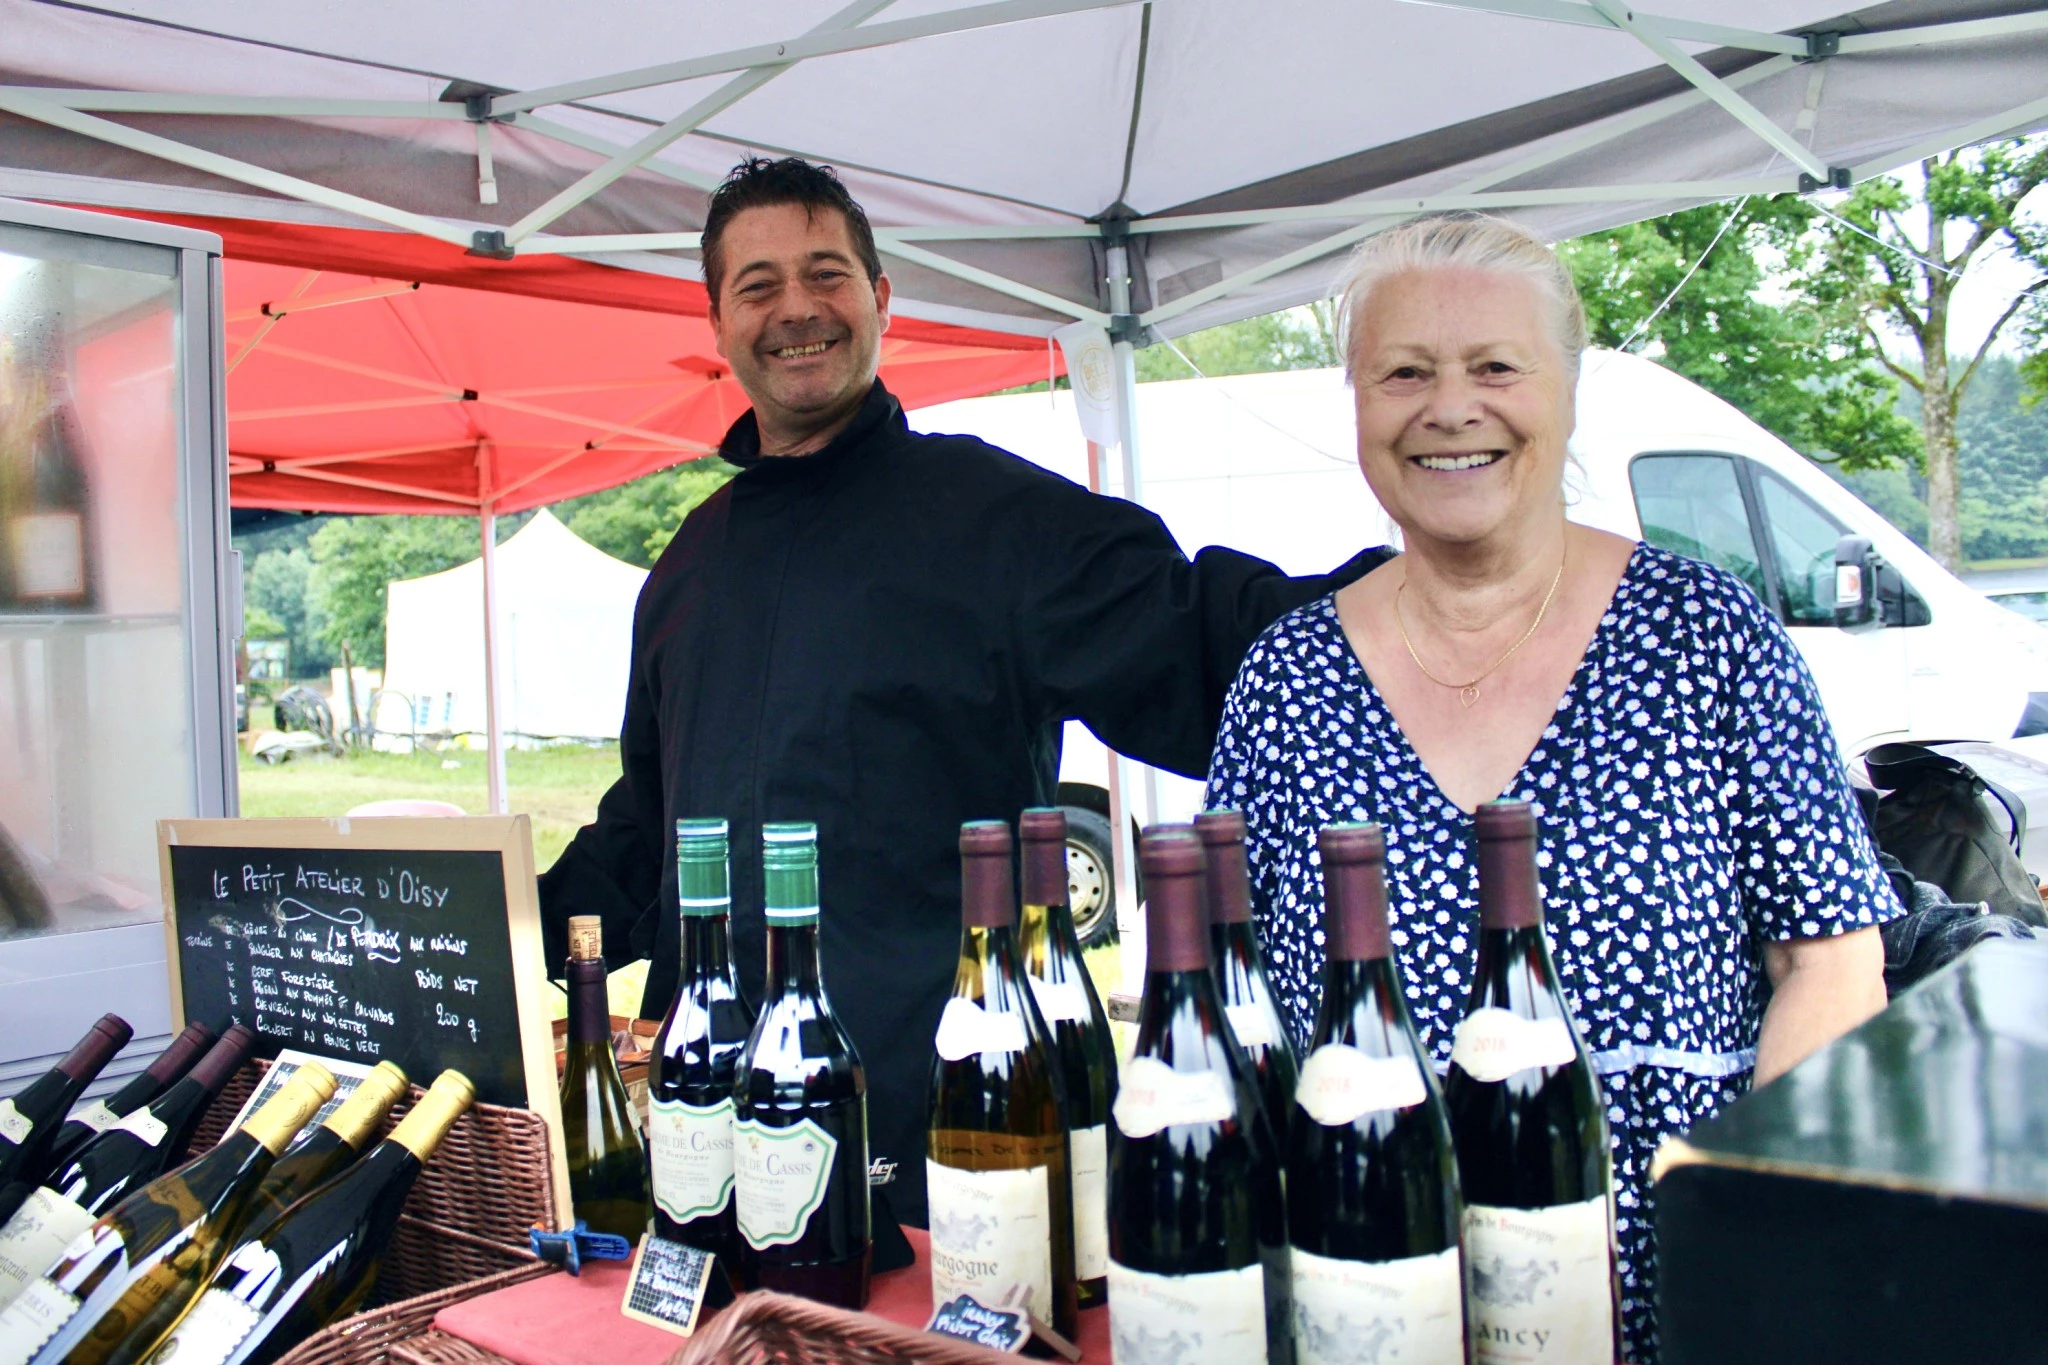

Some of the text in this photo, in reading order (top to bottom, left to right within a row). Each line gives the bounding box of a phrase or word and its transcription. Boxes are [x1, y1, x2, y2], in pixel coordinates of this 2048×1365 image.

[213, 869, 229, 899] LE
[453, 976, 478, 995] NET
[355, 1001, 394, 1025] CALVADOS
[436, 1002, 459, 1027] 200
[356, 1041, 380, 1055] VERT
[691, 1131, 734, 1152] CASSIS
[766, 1153, 812, 1176] CASSIS
[1477, 1321, 1550, 1353] ancy
